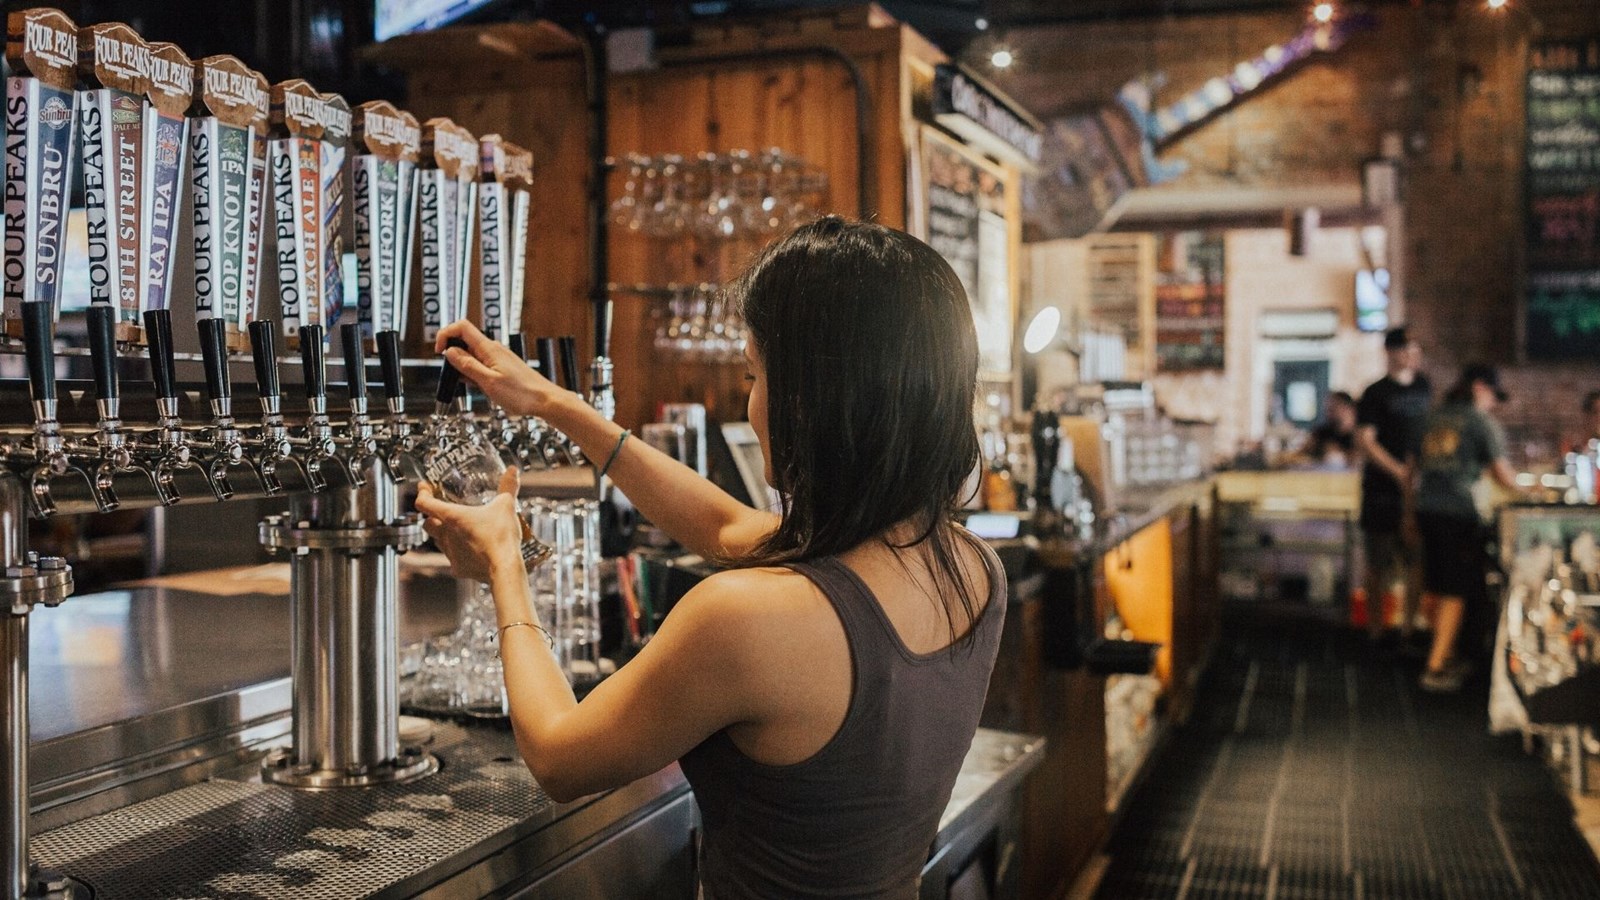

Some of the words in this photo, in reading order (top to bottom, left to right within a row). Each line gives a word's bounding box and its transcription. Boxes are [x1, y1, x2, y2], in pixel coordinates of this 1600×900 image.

[24, 20, 53, 53] FOUR
[94, 34, 120, 66] FOUR
[121, 41, 151, 79] PEAKS
[169, 61, 194, 97] PEAKS
[204, 66, 229, 95] FOUR
[229, 73, 257, 107] PEAKS
[284, 91, 304, 118] FOUR
[303, 95, 326, 128] PEAKS
[39, 107, 72, 122] Sunbru
[4, 95, 28, 204] PEAKS
[82, 106, 106, 211] PEAKS
[191, 132, 211, 227] PEAKS
[221, 159, 246, 176] IPA
[36, 146, 63, 285] SUNBRU
[119, 136, 136, 241] STREET
[154, 180, 172, 229] IPA
[223, 178, 241, 256] KNOT
[273, 153, 295, 242] PEAKS
[302, 177, 315, 227] ALE
[353, 168, 370, 250] PEAKS
[421, 182, 438, 258] PEAKS
[4, 209, 26, 301] FOUR
[87, 216, 110, 306] FOUR
[148, 233, 169, 288] RAJ
[380, 193, 395, 329] PITCHFORK
[480, 195, 498, 266] PEAKS
[119, 247, 136, 303] 8TH
[194, 232, 212, 313] FOUR
[222, 259, 239, 318] HOP
[278, 246, 299, 320] FOUR
[303, 231, 318, 314] PEACH
[357, 256, 372, 324] FOUR
[423, 264, 440, 327] FOUR
[483, 272, 501, 332] FOUR
[425, 456, 451, 489] FOUR
